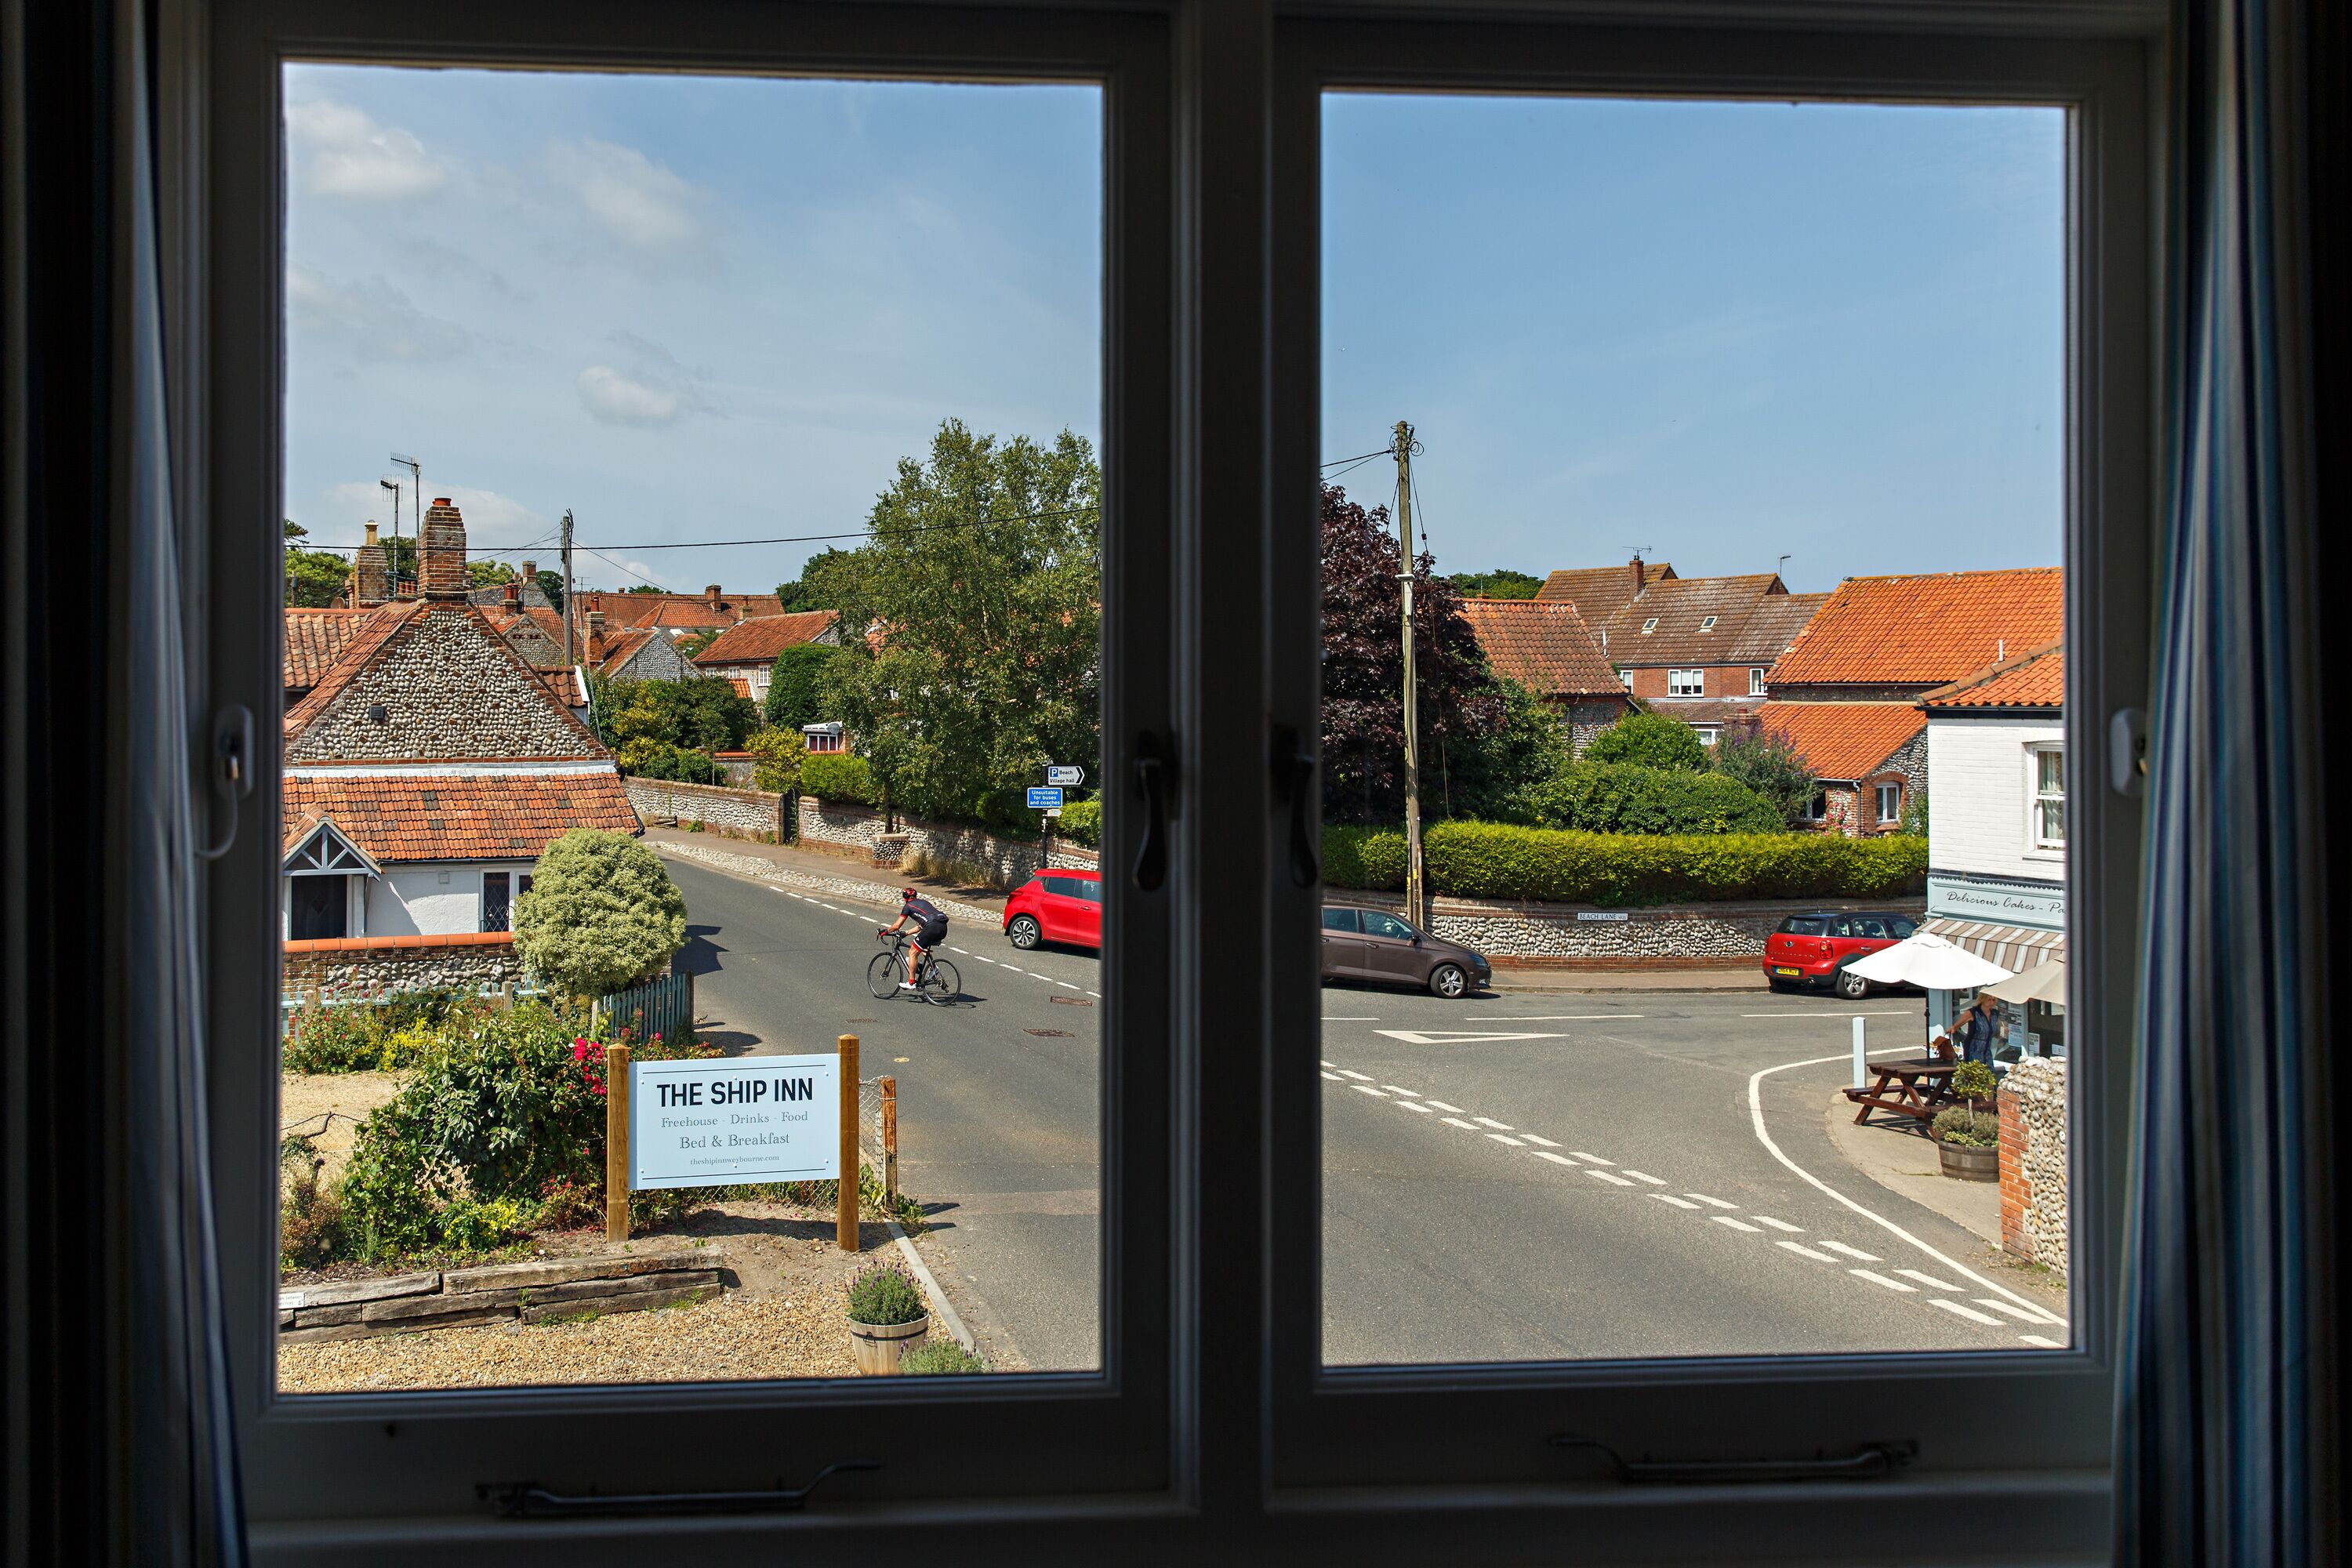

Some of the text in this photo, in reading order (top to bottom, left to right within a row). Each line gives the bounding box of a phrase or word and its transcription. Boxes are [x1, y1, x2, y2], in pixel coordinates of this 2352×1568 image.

[1947, 891, 1999, 906] Delicious
[2003, 897, 2036, 910] Cakes
[656, 1078, 813, 1107] THE SHIP INN
[661, 1116, 718, 1128] Freehouse
[730, 1113, 770, 1125] Drinks
[781, 1111, 808, 1122] Food
[680, 1132, 789, 1149] Bed & Breakfast
[690, 1154, 780, 1166] theshipinnweybourne.com
